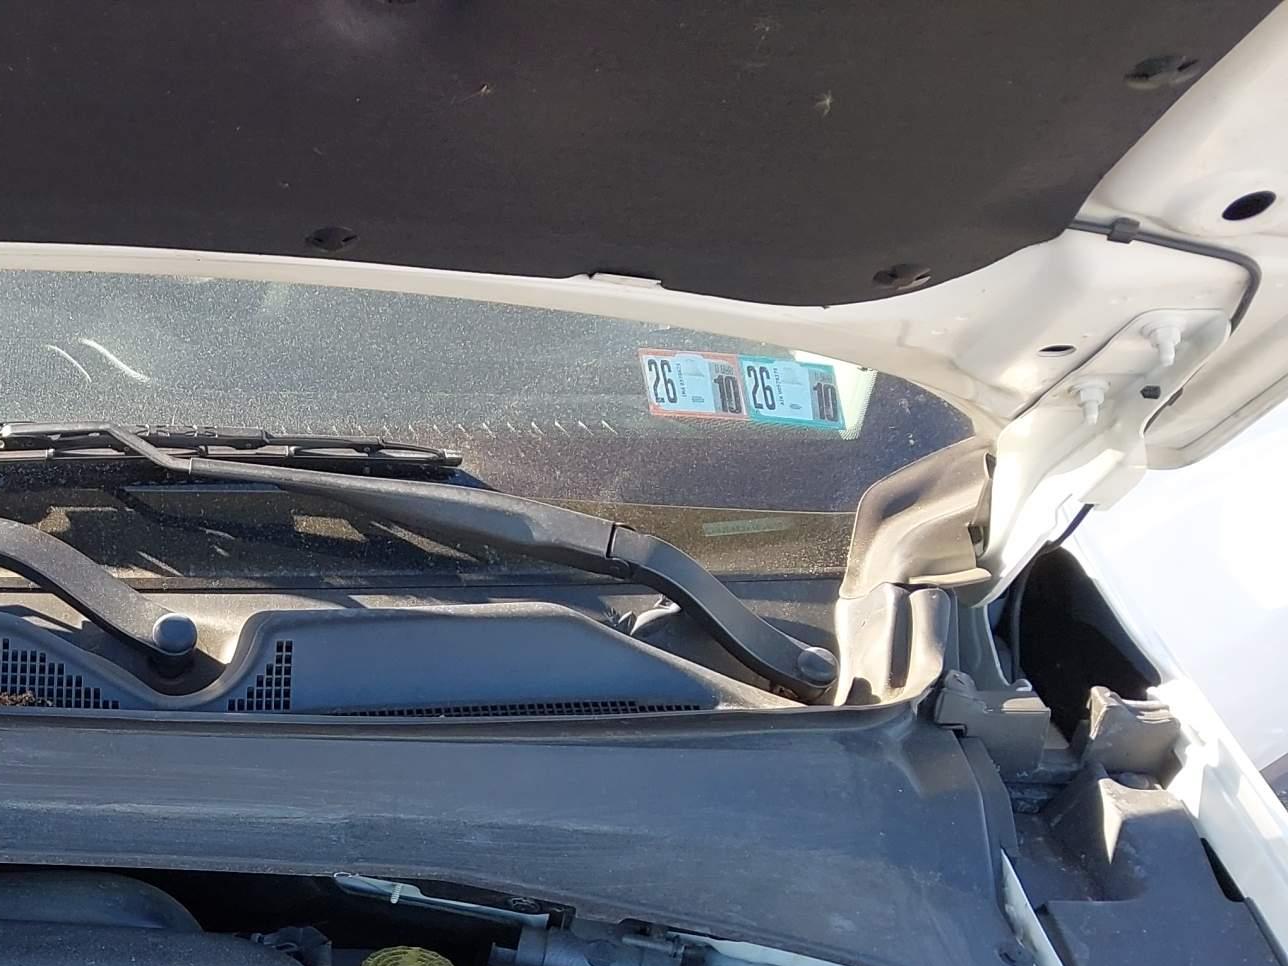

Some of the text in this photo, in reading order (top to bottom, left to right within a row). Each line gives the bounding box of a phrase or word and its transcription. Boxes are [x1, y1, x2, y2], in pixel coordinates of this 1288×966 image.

[647, 359, 678, 405] 26
[713, 374, 742, 415] 10
[747, 365, 776, 411] 26
[813, 382, 839, 422] 10
